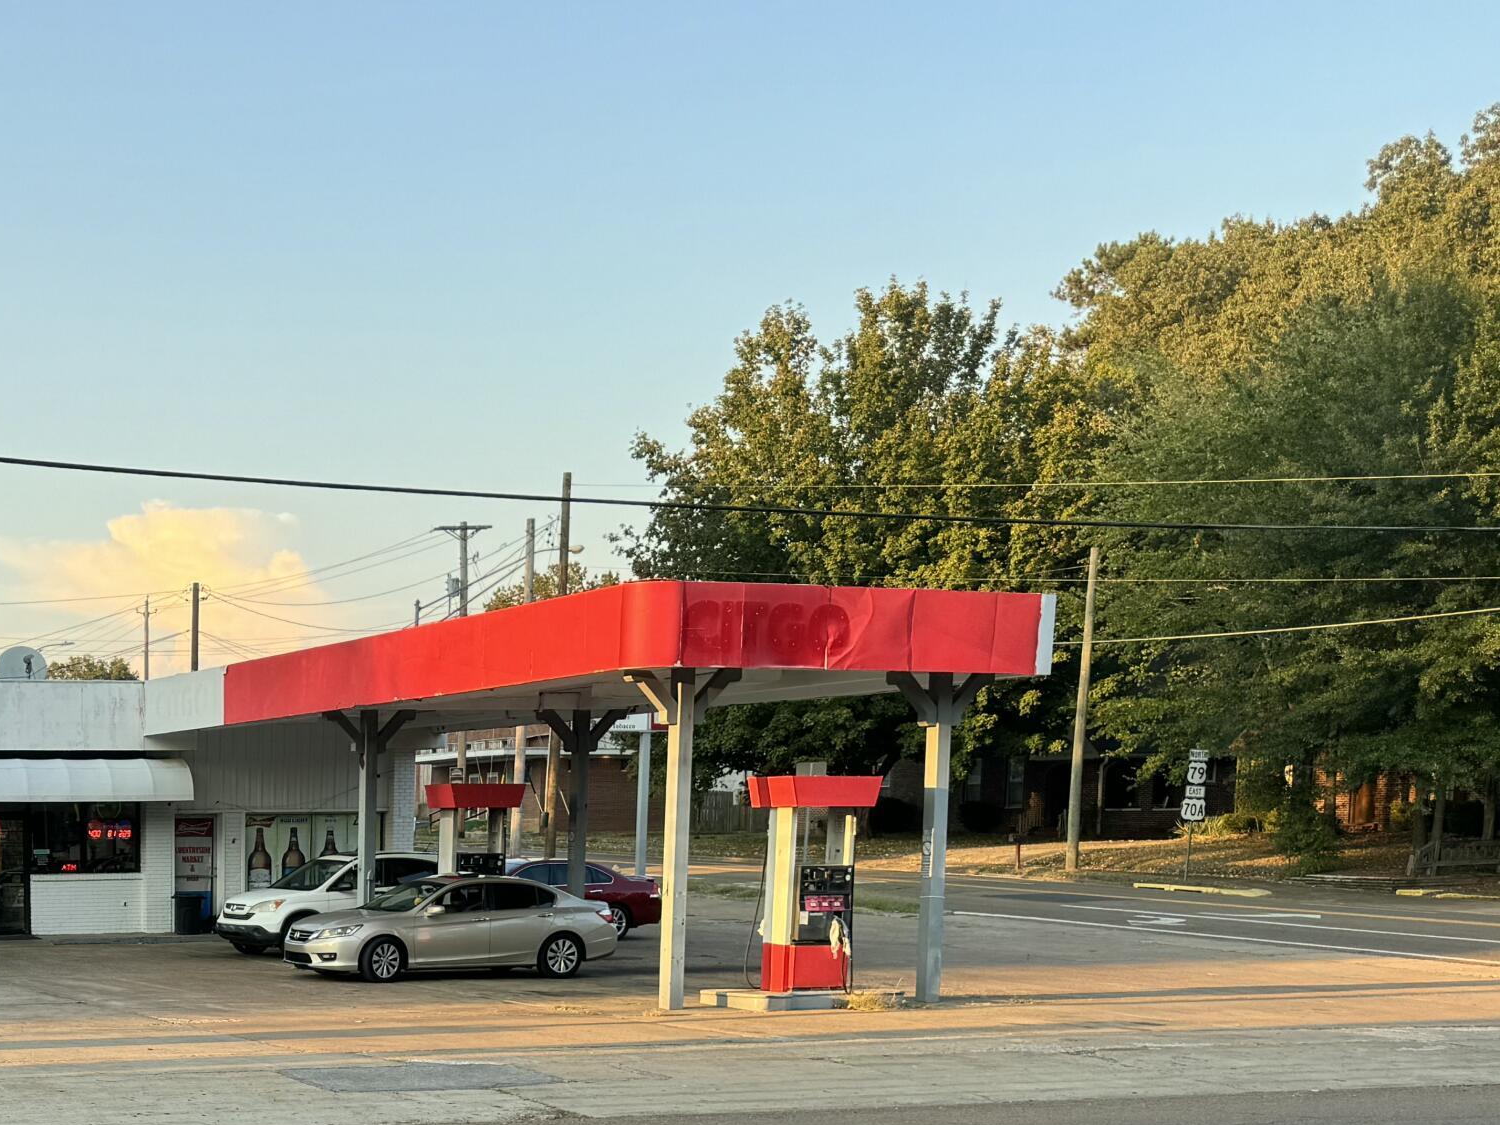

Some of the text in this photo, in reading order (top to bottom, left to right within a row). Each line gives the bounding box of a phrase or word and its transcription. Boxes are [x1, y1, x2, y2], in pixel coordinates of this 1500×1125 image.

[686, 599, 851, 657] CITGO
[1190, 767, 1205, 780] 79
[1189, 787, 1202, 795] EAST
[1184, 803, 1204, 816] 70A
